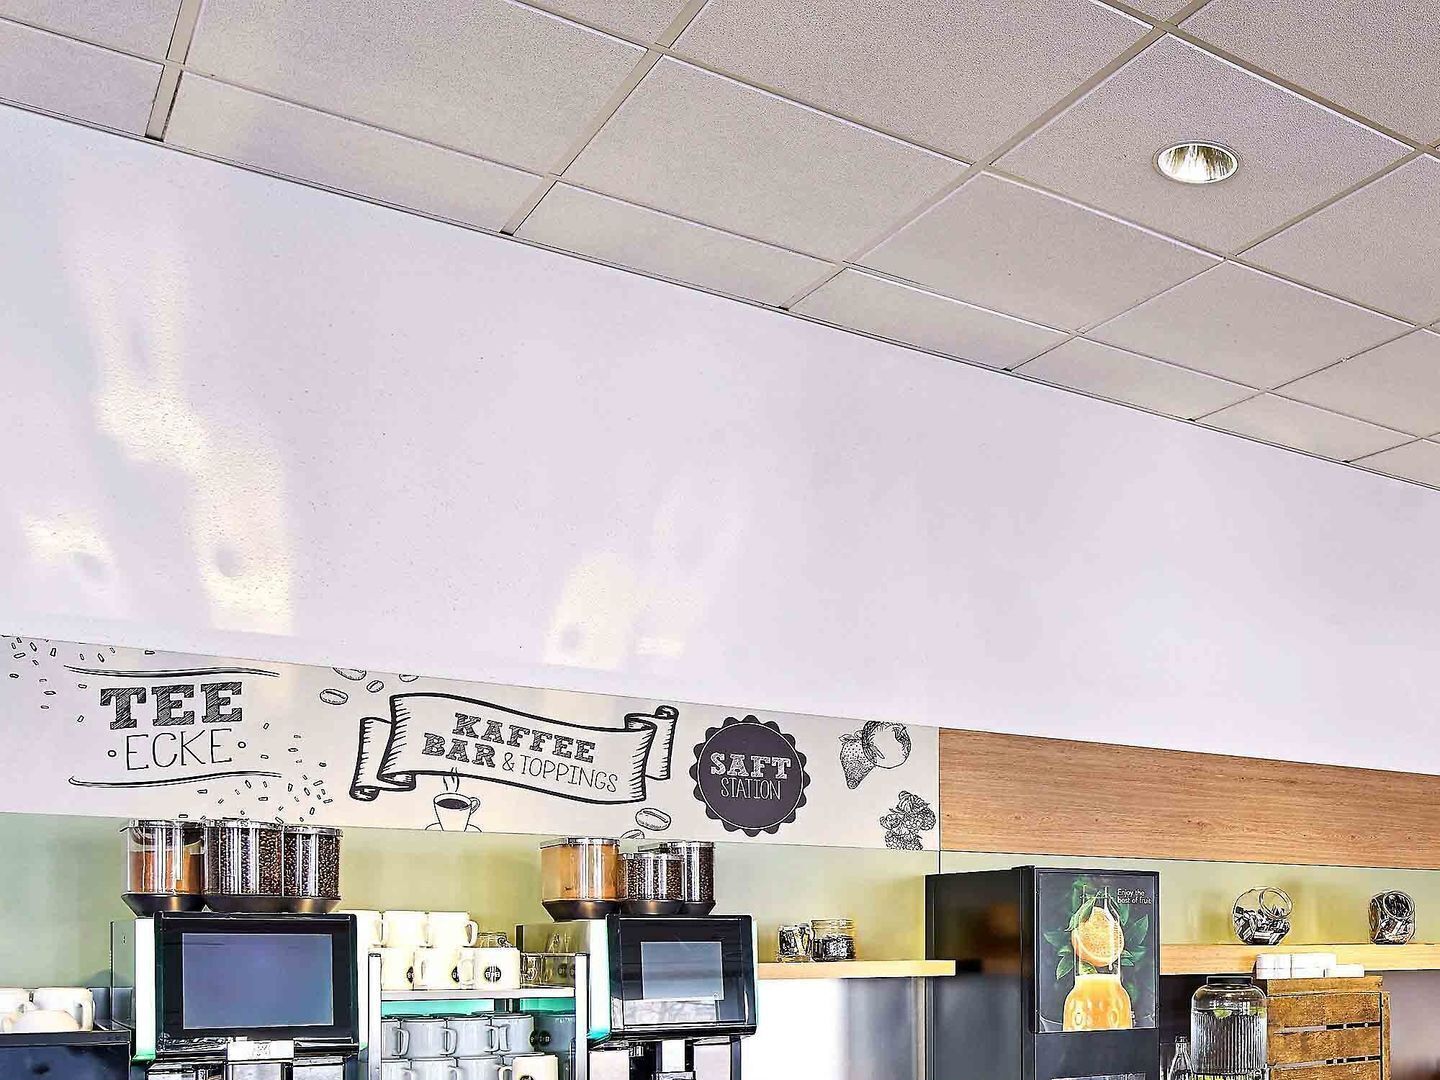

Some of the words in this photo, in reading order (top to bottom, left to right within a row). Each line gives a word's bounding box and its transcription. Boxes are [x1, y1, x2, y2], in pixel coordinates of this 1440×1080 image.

[100, 681, 243, 730] TEE
[125, 728, 232, 771] ECKE
[452, 712, 596, 763] KAFFEE
[422, 732, 496, 768] BAR
[502, 752, 515, 773] &
[520, 754, 618, 793] TOPPINGS
[710, 752, 791, 779] SAFT
[721, 777, 781, 800] STATION
[1117, 888, 1134, 898] Enjoy
